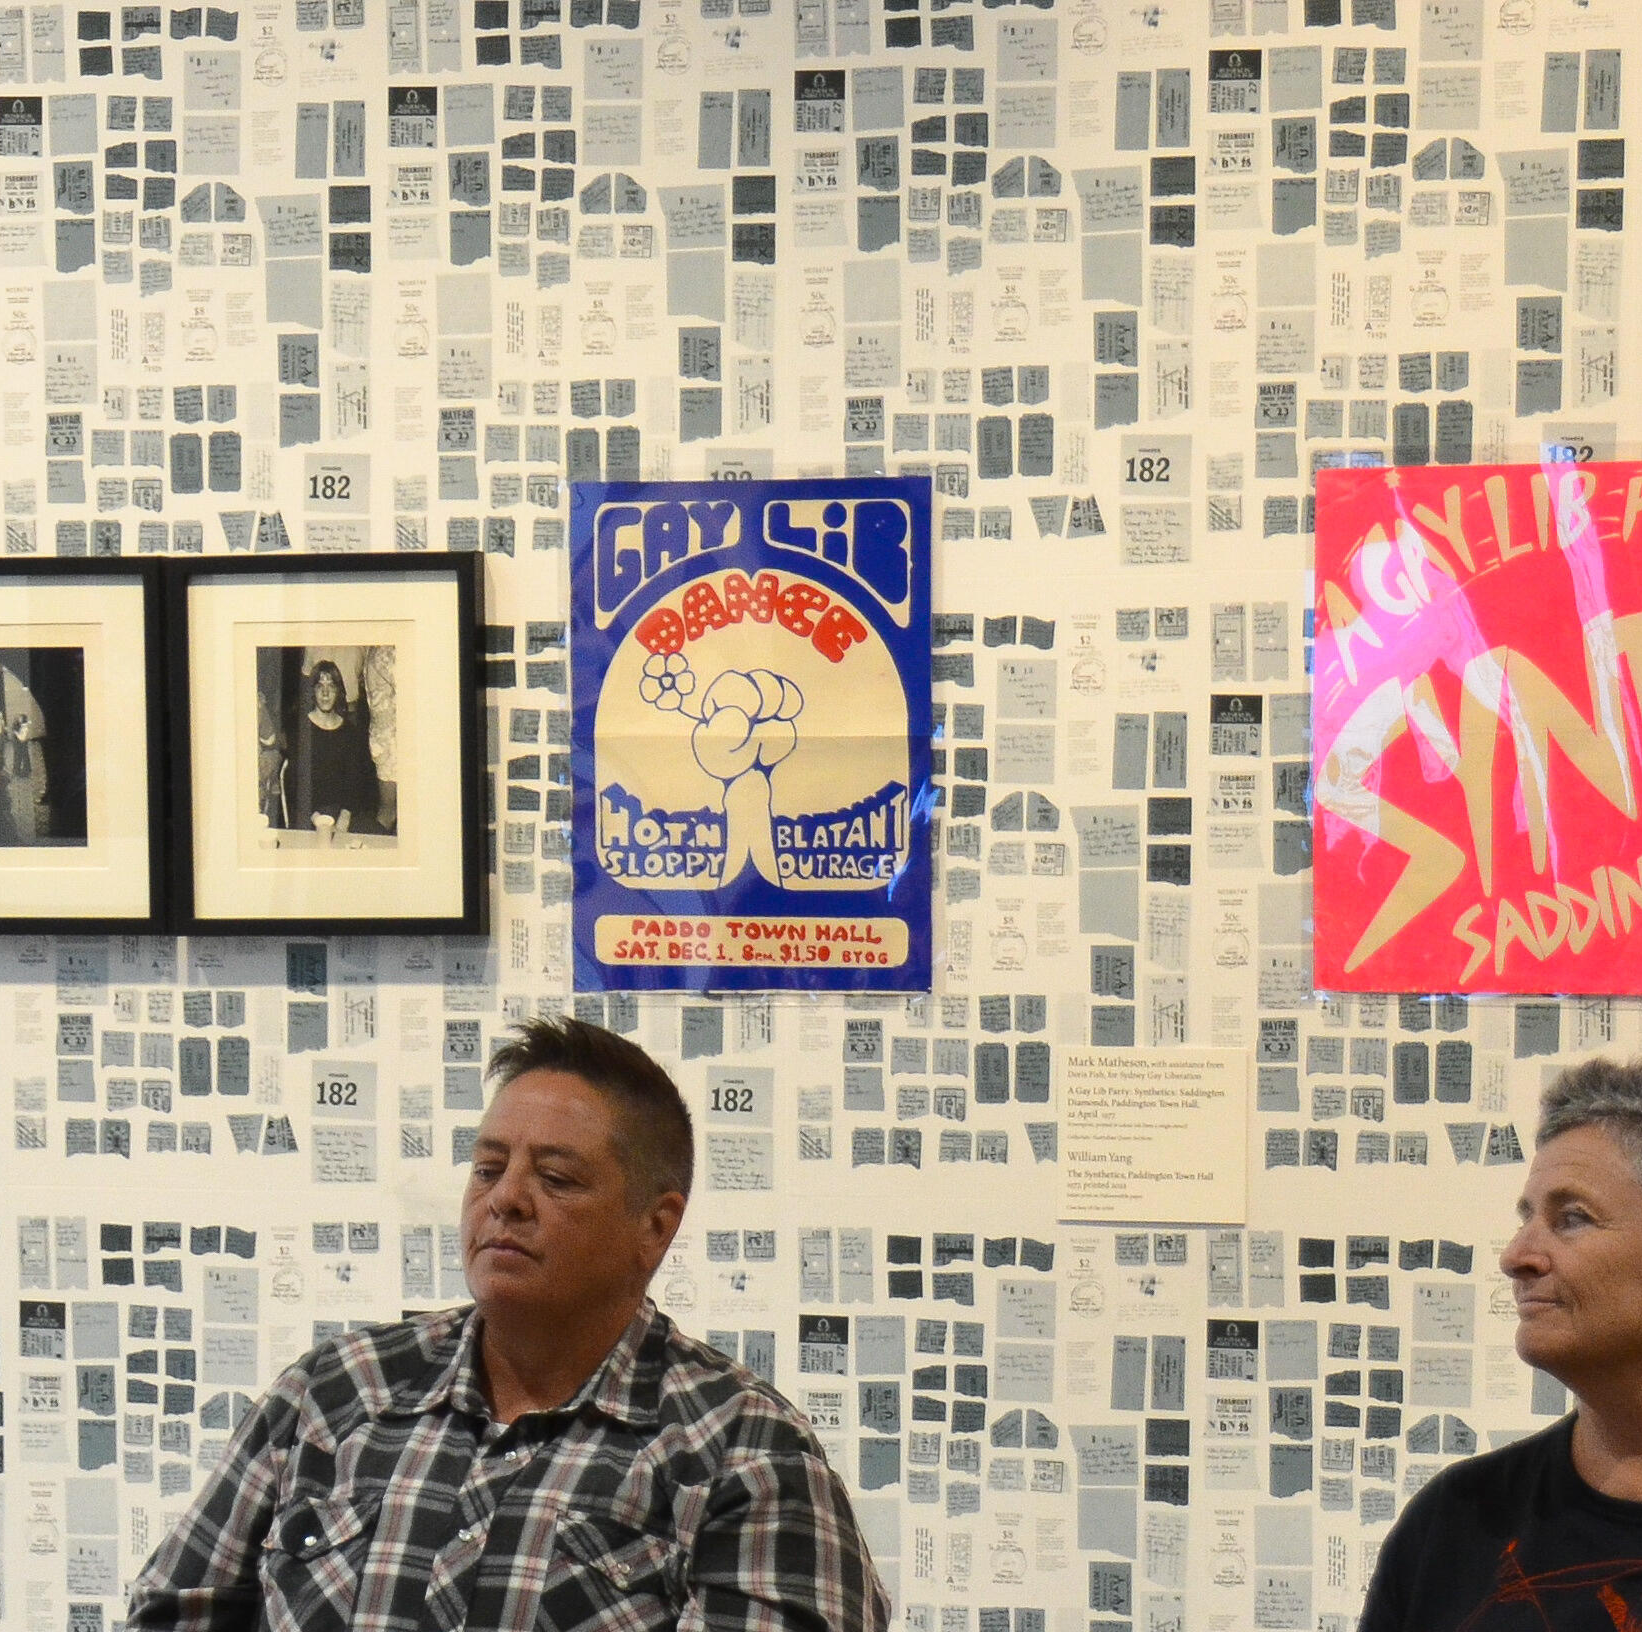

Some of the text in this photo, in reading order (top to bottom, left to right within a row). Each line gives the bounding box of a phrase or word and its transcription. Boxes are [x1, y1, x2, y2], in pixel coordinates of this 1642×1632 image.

[1258, 384, 1296, 396] MAYFAIR
[848, 398, 884, 410] MAYFAIR
[1125, 457, 1170, 483] 182
[309, 475, 351, 500] 182
[595, 500, 740, 616] GAY
[1324, 580, 1383, 686] A
[1360, 485, 1475, 616] GAY
[1485, 471, 1596, 562] LIB
[635, 573, 868, 663] DANCE
[777, 790, 907, 849] BLATANT
[607, 851, 894, 879] SLOPPY OUTRAGE
[631, 920, 882, 944] PADDO TOWN HALL
[1261, 1020, 1297, 1032] MAYFAIR
[1068, 1057, 1094, 1067] Mark
[316, 1081, 357, 1106] 182
[711, 1087, 753, 1113] 182
[1075, 1088, 1090, 1097] Gay
[1180, 1088, 1224, 1098] Saddington
[1111, 1100, 1156, 1110] Paddington
[1159, 1100, 1179, 1108] Town
[1077, 1110, 1097, 1120] April
[1068, 1152, 1132, 1165] William Yang
[1128, 1171, 1172, 1182] Paddington
[1175, 1172, 1195, 1180] Town
[1083, 1182, 1109, 1190] printed
